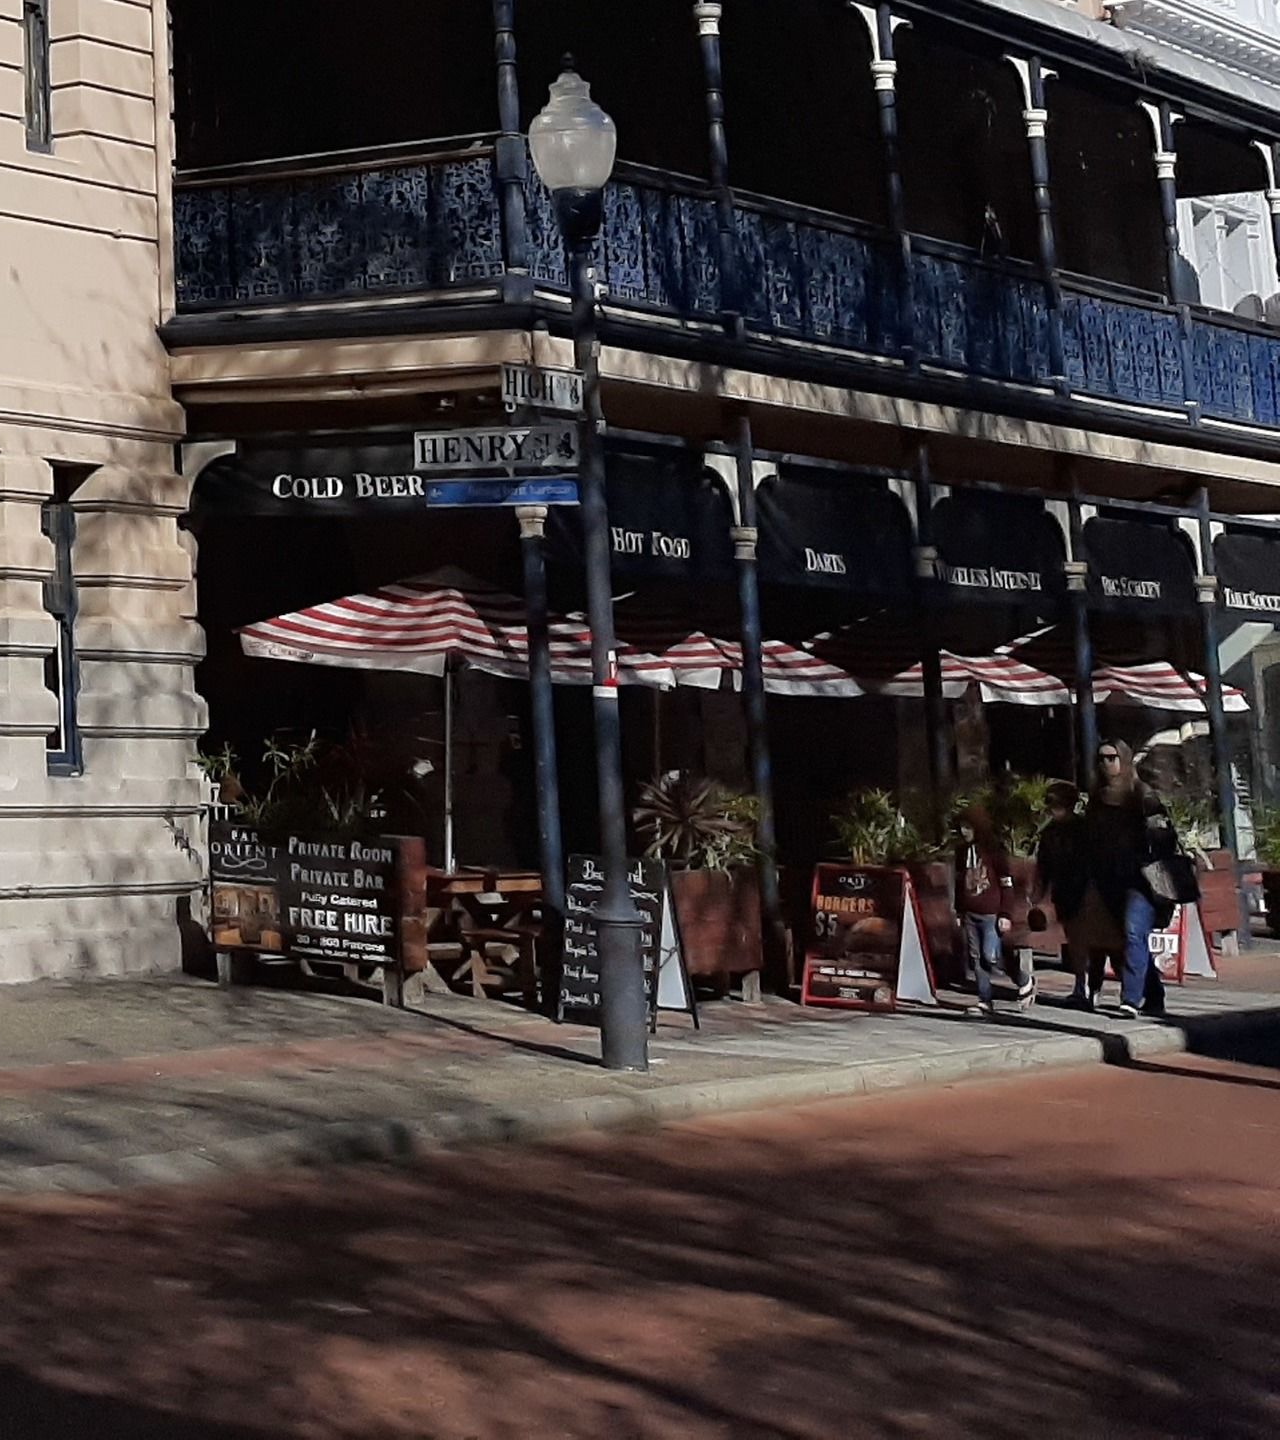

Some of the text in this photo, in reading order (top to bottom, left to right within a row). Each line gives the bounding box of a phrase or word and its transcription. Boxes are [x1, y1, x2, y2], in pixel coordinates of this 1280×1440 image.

[505, 366, 555, 402] HIGH
[418, 433, 530, 464] HENRY
[272, 472, 426, 499] COLD BEER
[611, 526, 690, 559] HOT FOOD
[804, 547, 847, 574] DARTS
[210, 841, 277, 869] ORIENT
[288, 836, 393, 864] PRIVATE ROOM
[290, 863, 385, 890] PRIVATE BAR
[816, 895, 875, 914] BURGERS
[288, 906, 395, 937] FREE HIRE
[815, 911, 839, 937] $5
